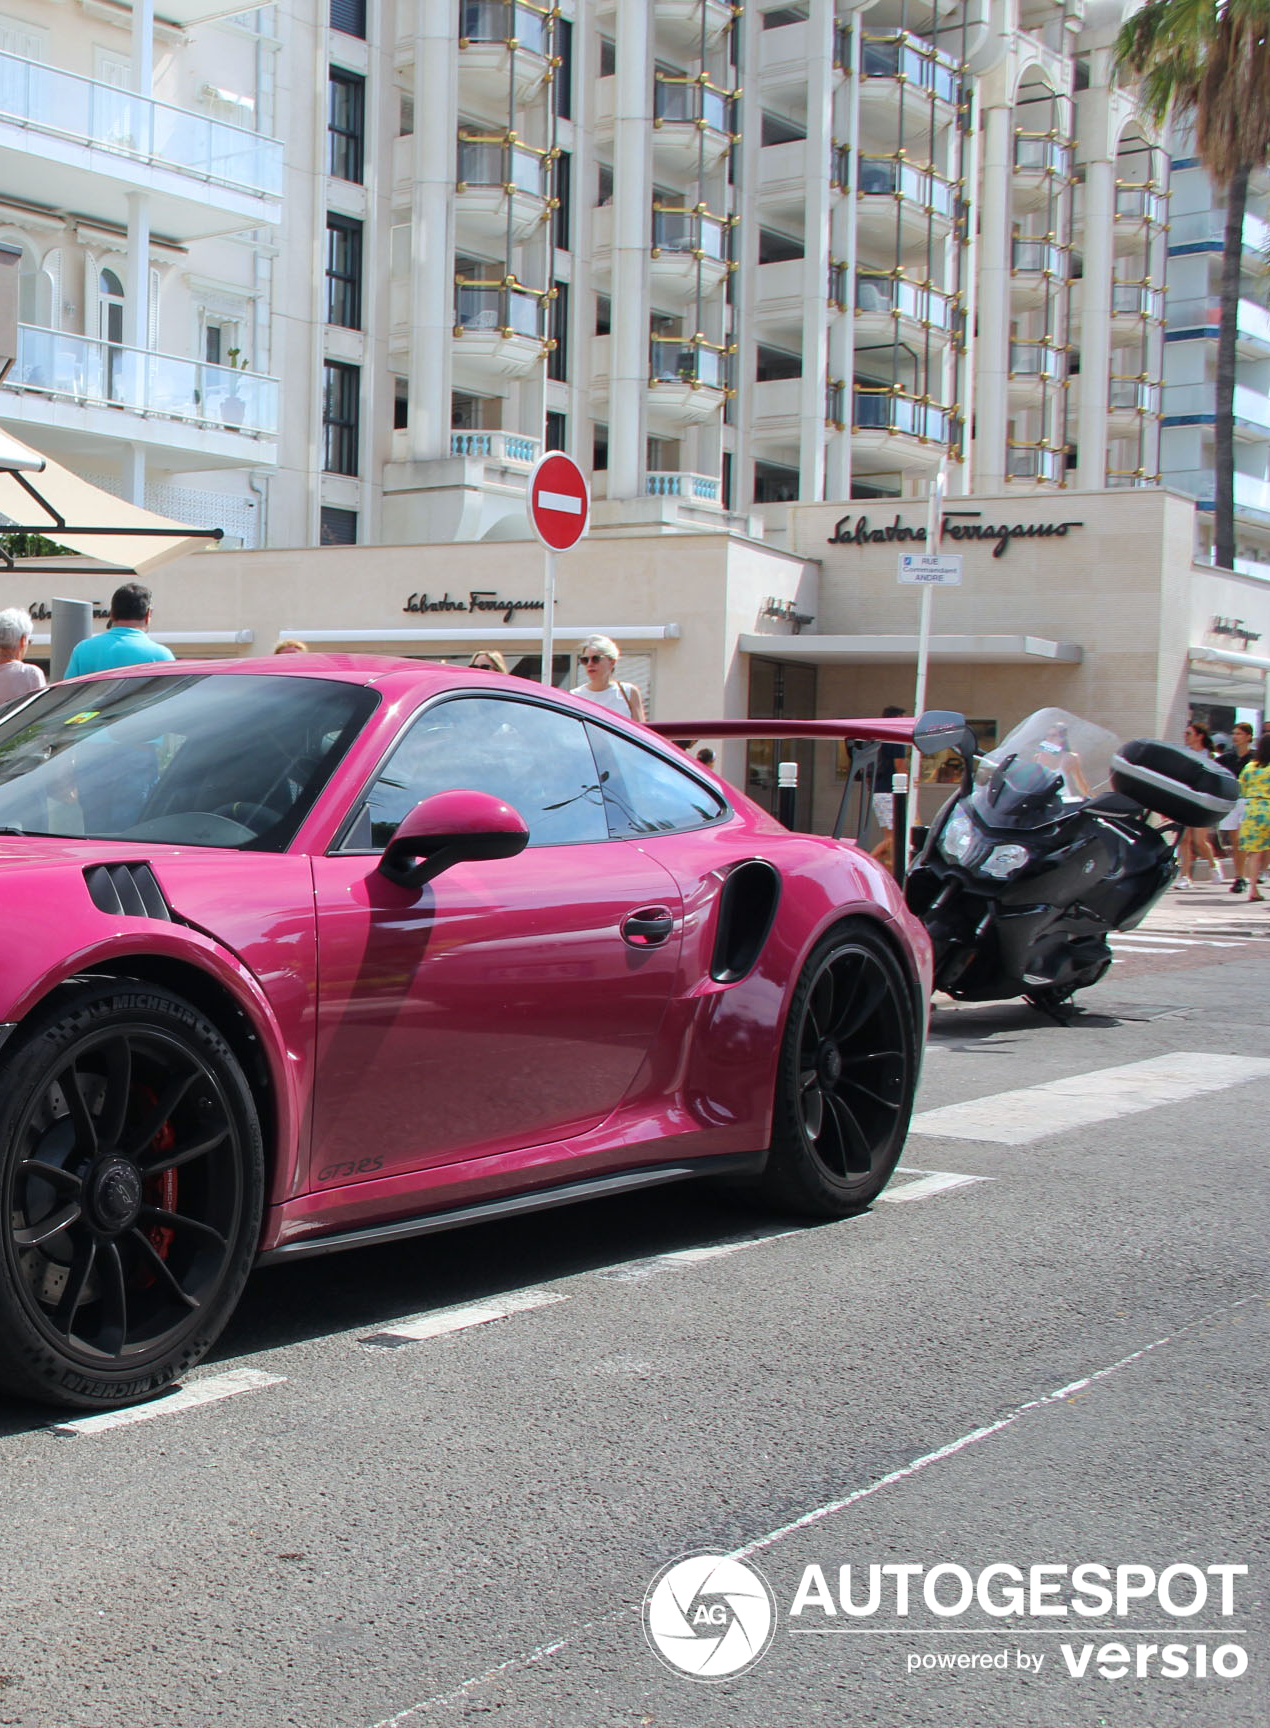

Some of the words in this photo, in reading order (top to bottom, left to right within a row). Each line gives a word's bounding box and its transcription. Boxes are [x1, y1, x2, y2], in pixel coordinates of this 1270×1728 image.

[828, 514, 928, 545] Salvatore
[939, 511, 1083, 559] Ferragamo
[902, 566, 958, 574] Commandant
[921, 557, 939, 566] RUE
[402, 592, 468, 615] Salvatore
[468, 591, 558, 624] Ferragam
[112, 994, 197, 1027] MICHELIN
[60, 1370, 152, 1399] MICHELIN
